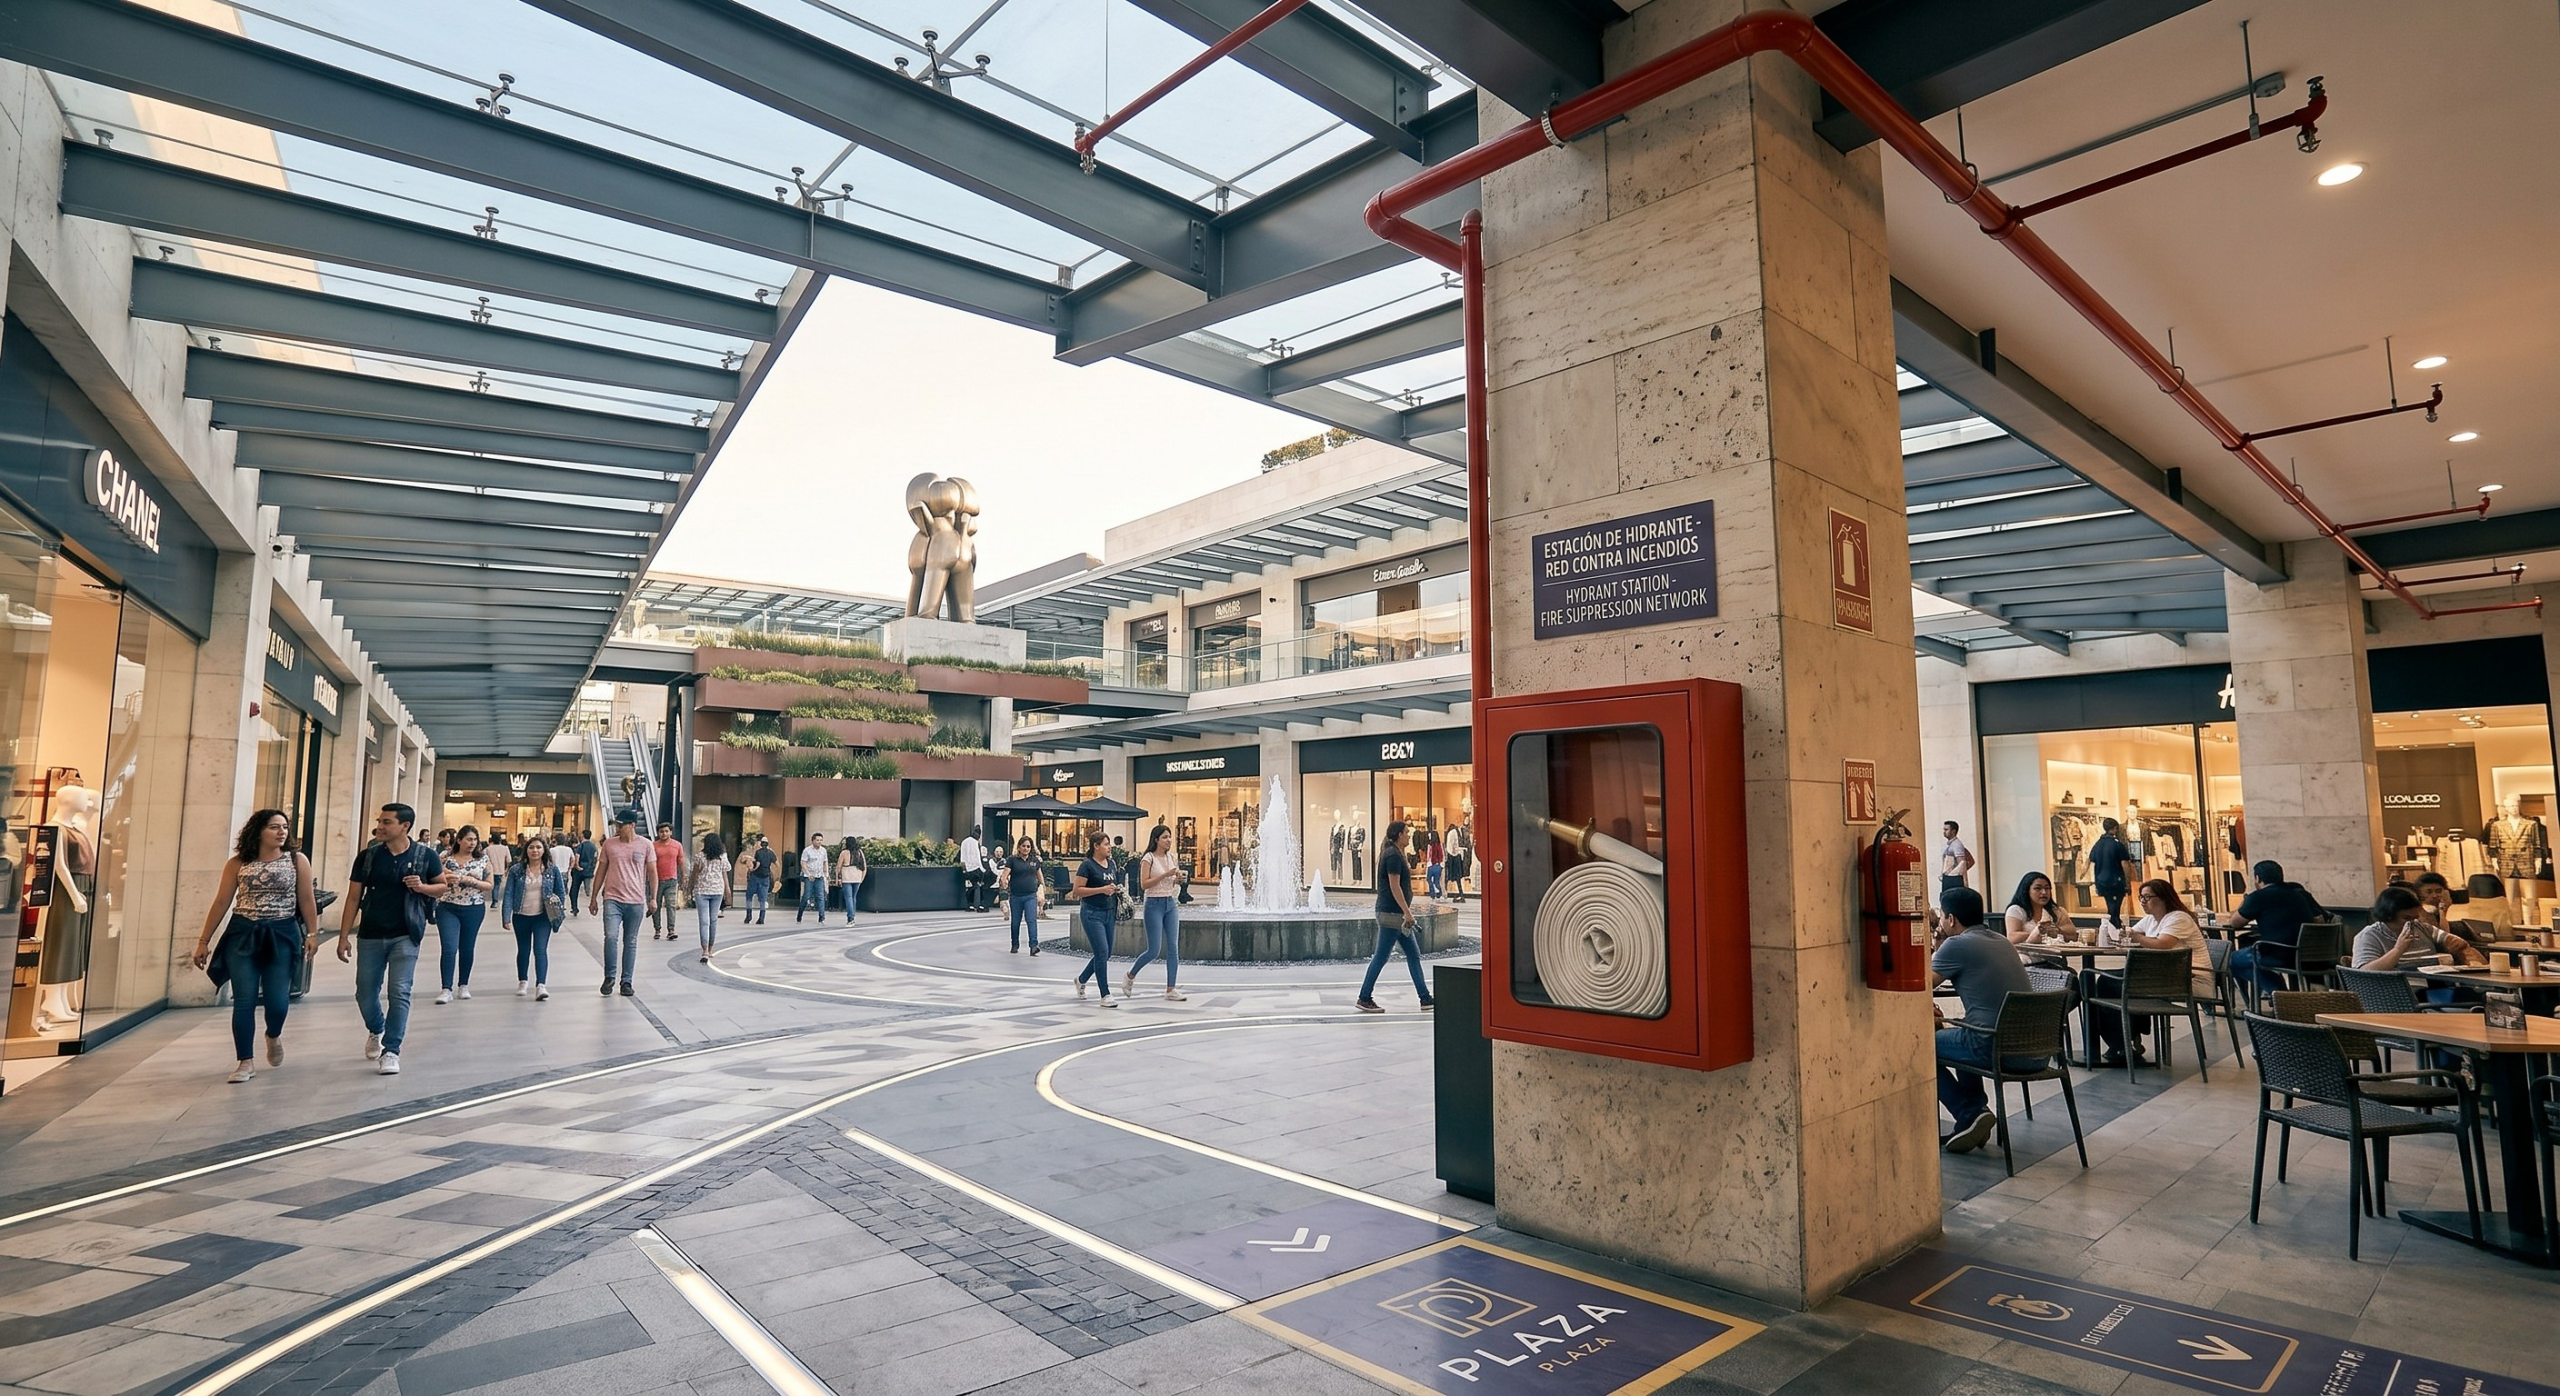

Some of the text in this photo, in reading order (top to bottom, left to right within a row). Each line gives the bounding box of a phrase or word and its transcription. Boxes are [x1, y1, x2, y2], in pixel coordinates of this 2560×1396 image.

[96, 449, 161, 555] CHANEL
[1544, 531, 1602, 558] ESTACIÓN
[1605, 529, 1622, 548] DE
[1625, 515, 1693, 544] HIDRANTE
[1546, 535, 1699, 578] RED CONTRA INCENDIOS
[1541, 588, 1708, 627] FIRE SUPPRESSION NETWORK
[1566, 582, 1618, 605] HYDRANT
[1621, 574, 1669, 596] STATION
[1437, 1303, 1628, 1382] PLAZA
[1538, 1336, 1616, 1372] PLAZA
